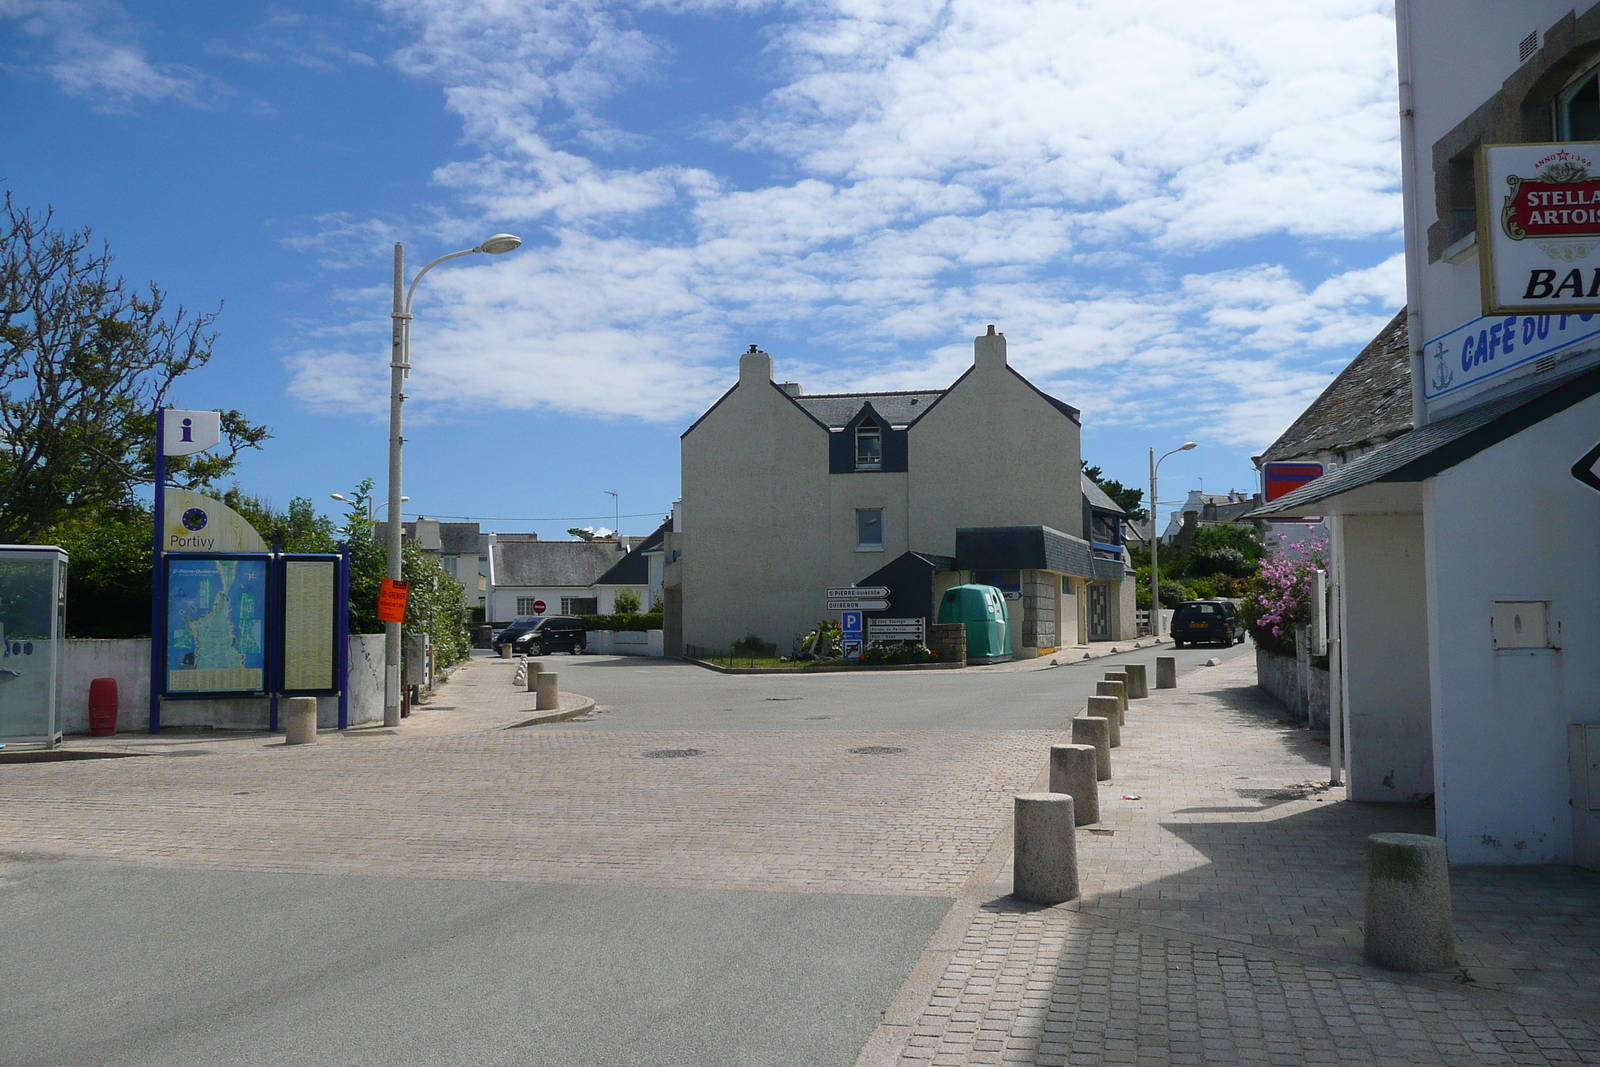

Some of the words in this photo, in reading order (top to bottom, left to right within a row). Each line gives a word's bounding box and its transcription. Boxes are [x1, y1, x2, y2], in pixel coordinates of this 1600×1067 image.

[1534, 154, 1556, 169] ANNO
[1571, 154, 1592, 167] 1366
[170, 535, 215, 550] Portivy
[847, 614, 857, 629] P
